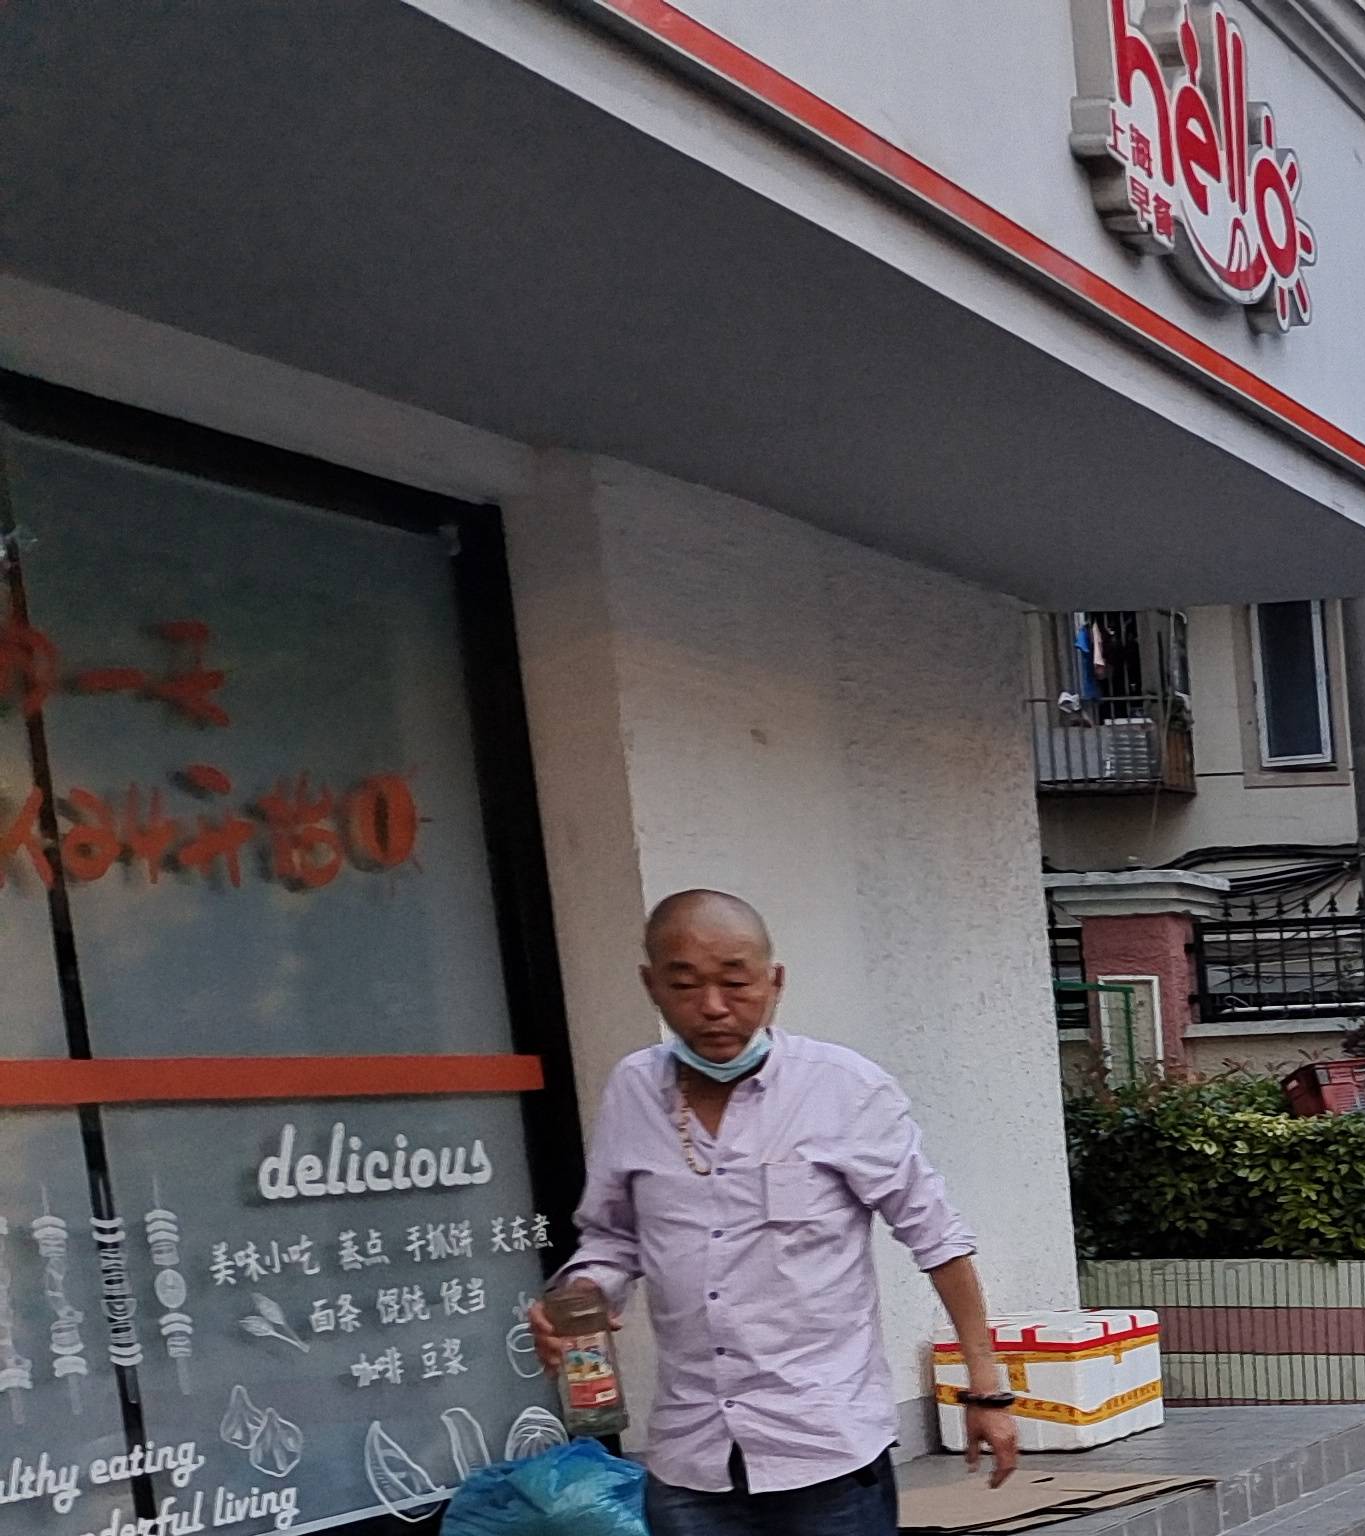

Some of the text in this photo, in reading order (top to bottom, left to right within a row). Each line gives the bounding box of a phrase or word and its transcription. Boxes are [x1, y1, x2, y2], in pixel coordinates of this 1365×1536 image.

[1110, 0, 1300, 279] hello
[258, 1122, 492, 1200] delicious
[209, 1213, 554, 1286] 美味小吃 蒸点 手抓饼 关东煮
[309, 1294, 362, 1334] 面条
[440, 1277, 486, 1316] 便当
[351, 1338, 468, 1388] 咖啡 豆浆
[213, 1486, 300, 1531] living
